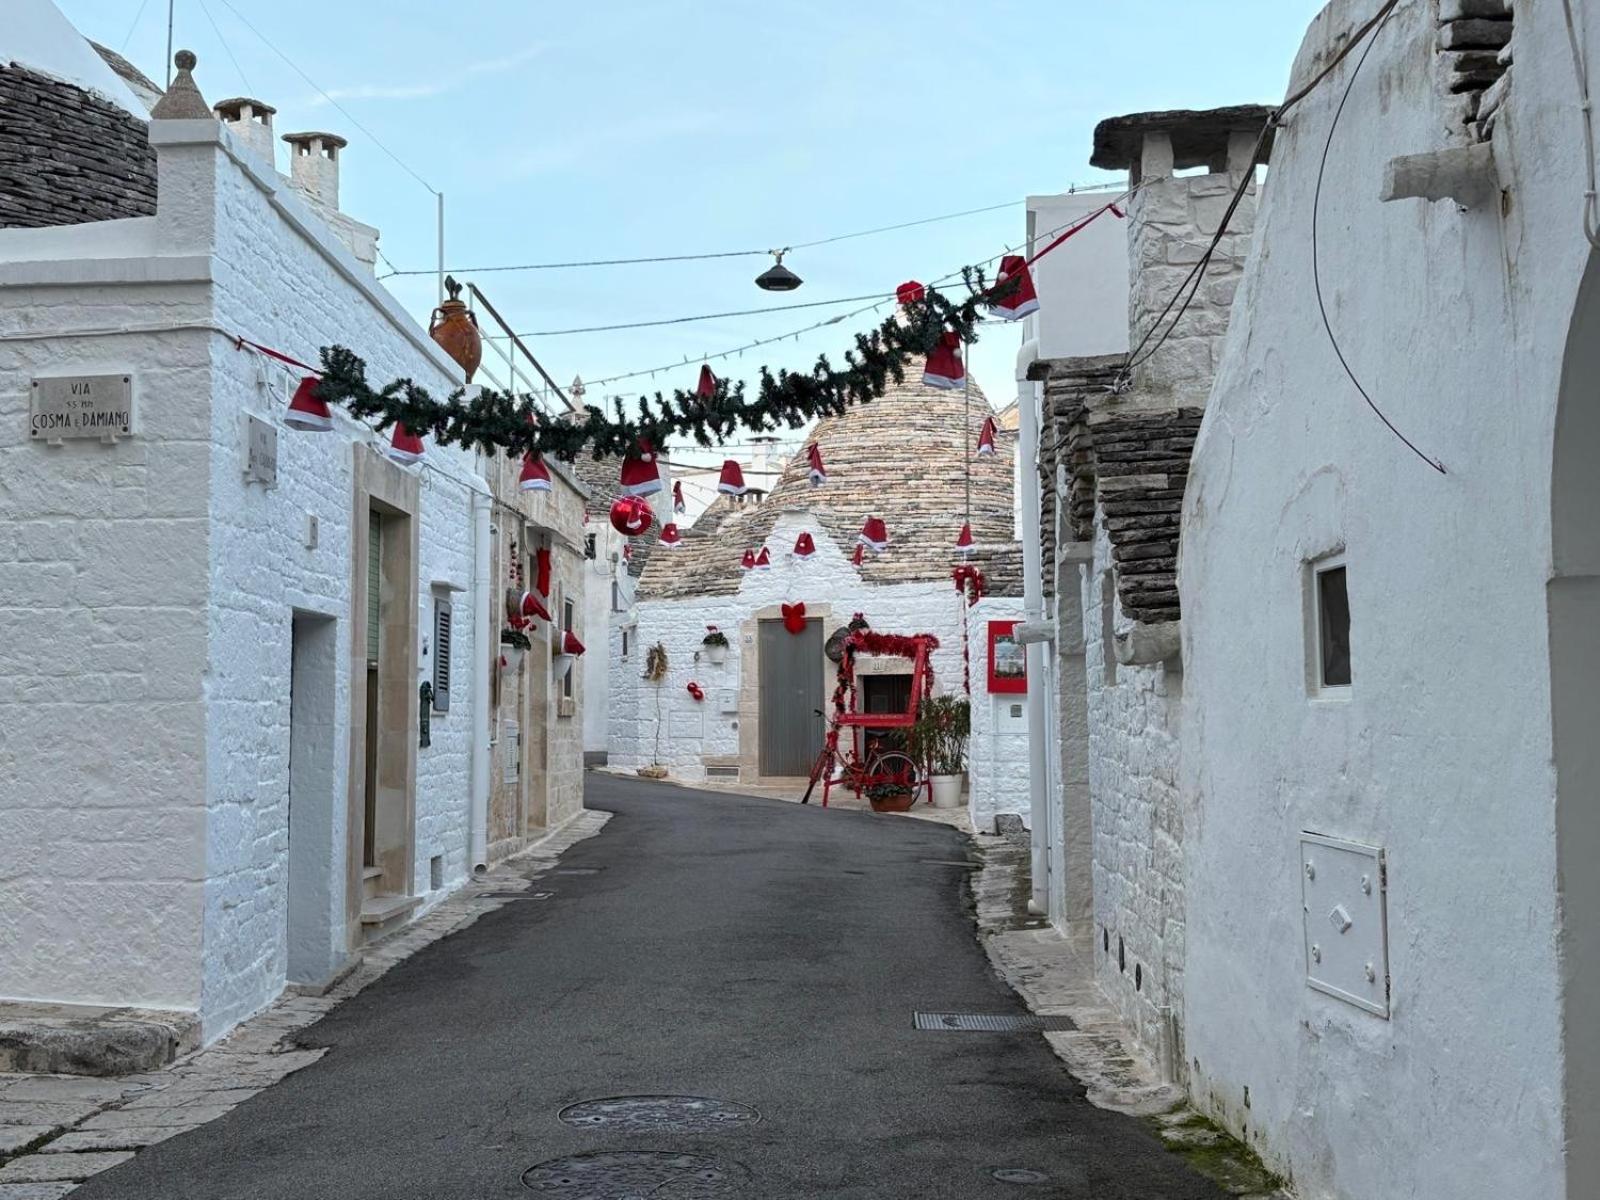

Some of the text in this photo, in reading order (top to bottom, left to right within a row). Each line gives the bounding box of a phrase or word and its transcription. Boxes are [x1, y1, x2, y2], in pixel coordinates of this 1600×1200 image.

[71, 383, 90, 395] VIA
[33, 413, 71, 429] COSMA
[82, 411, 129, 427] DAMIANO
